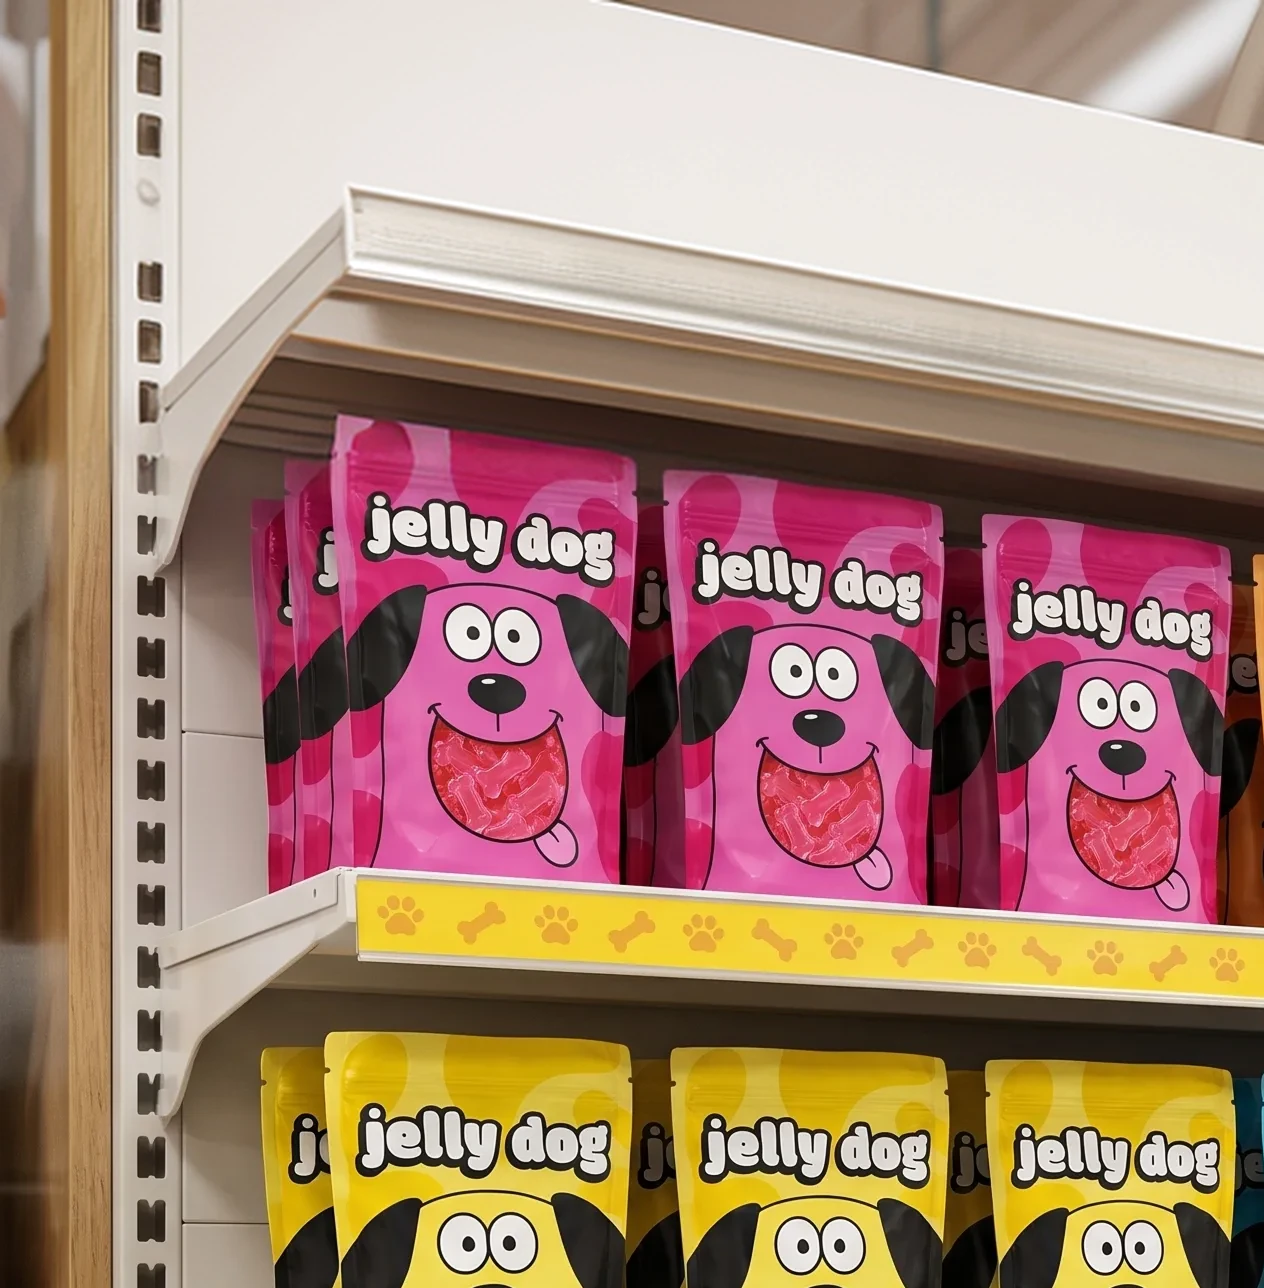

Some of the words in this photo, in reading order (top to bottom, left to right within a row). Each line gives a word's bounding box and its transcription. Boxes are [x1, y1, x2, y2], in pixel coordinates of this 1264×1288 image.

[364, 493, 506, 568] jelly
[514, 514, 615, 583] dog
[695, 539, 824, 610] jelly
[832, 558, 923, 623] dog
[1010, 579, 1127, 646] jelly
[1132, 597, 1213, 659] dog
[359, 1105, 500, 1173] jelly
[509, 1113, 610, 1177] dog
[702, 1116, 830, 1181] jelly
[838, 1123, 930, 1184] dog
[1014, 1125, 1131, 1186] jelly
[1137, 1132, 1220, 1189] dog
